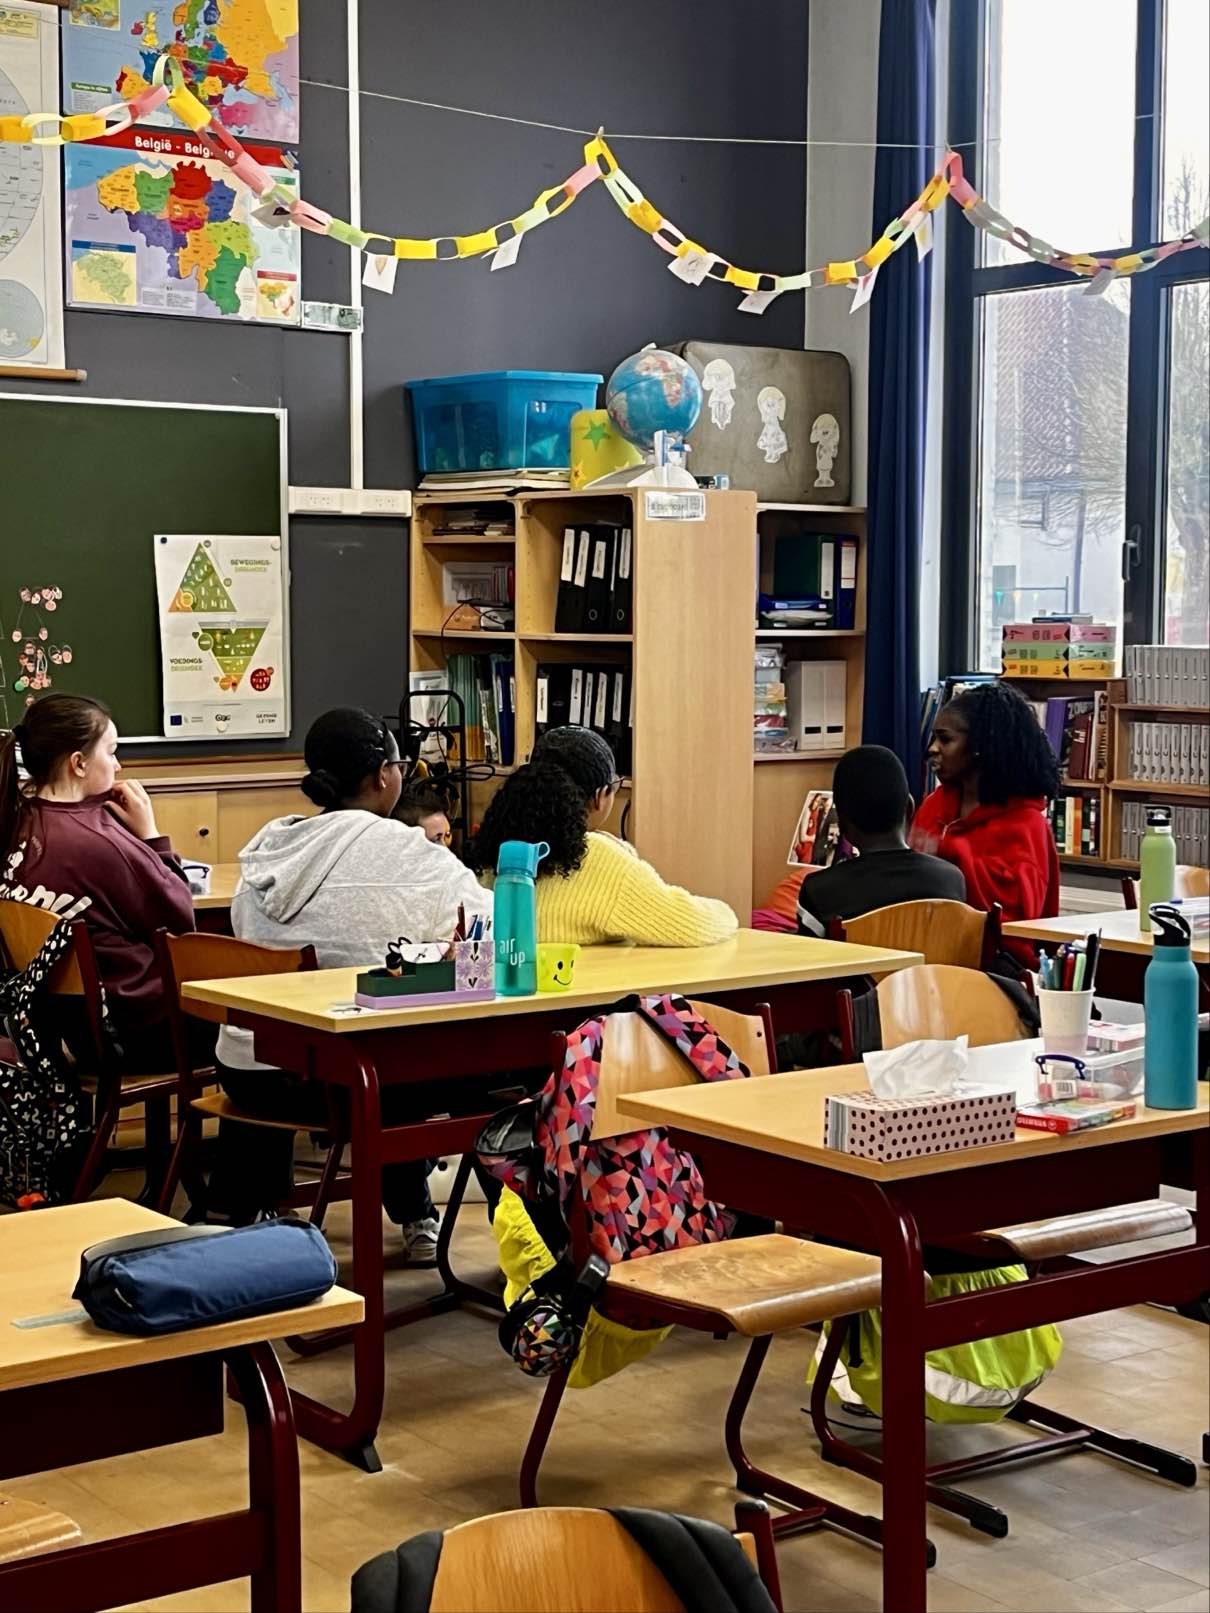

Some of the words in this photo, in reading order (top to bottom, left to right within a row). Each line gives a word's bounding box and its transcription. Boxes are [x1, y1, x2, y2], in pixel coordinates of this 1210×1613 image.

[135, 136, 172, 152] België
[185, 141, 235, 159] Belge
[499, 938, 516, 954] air
[510, 951, 526, 968] up
